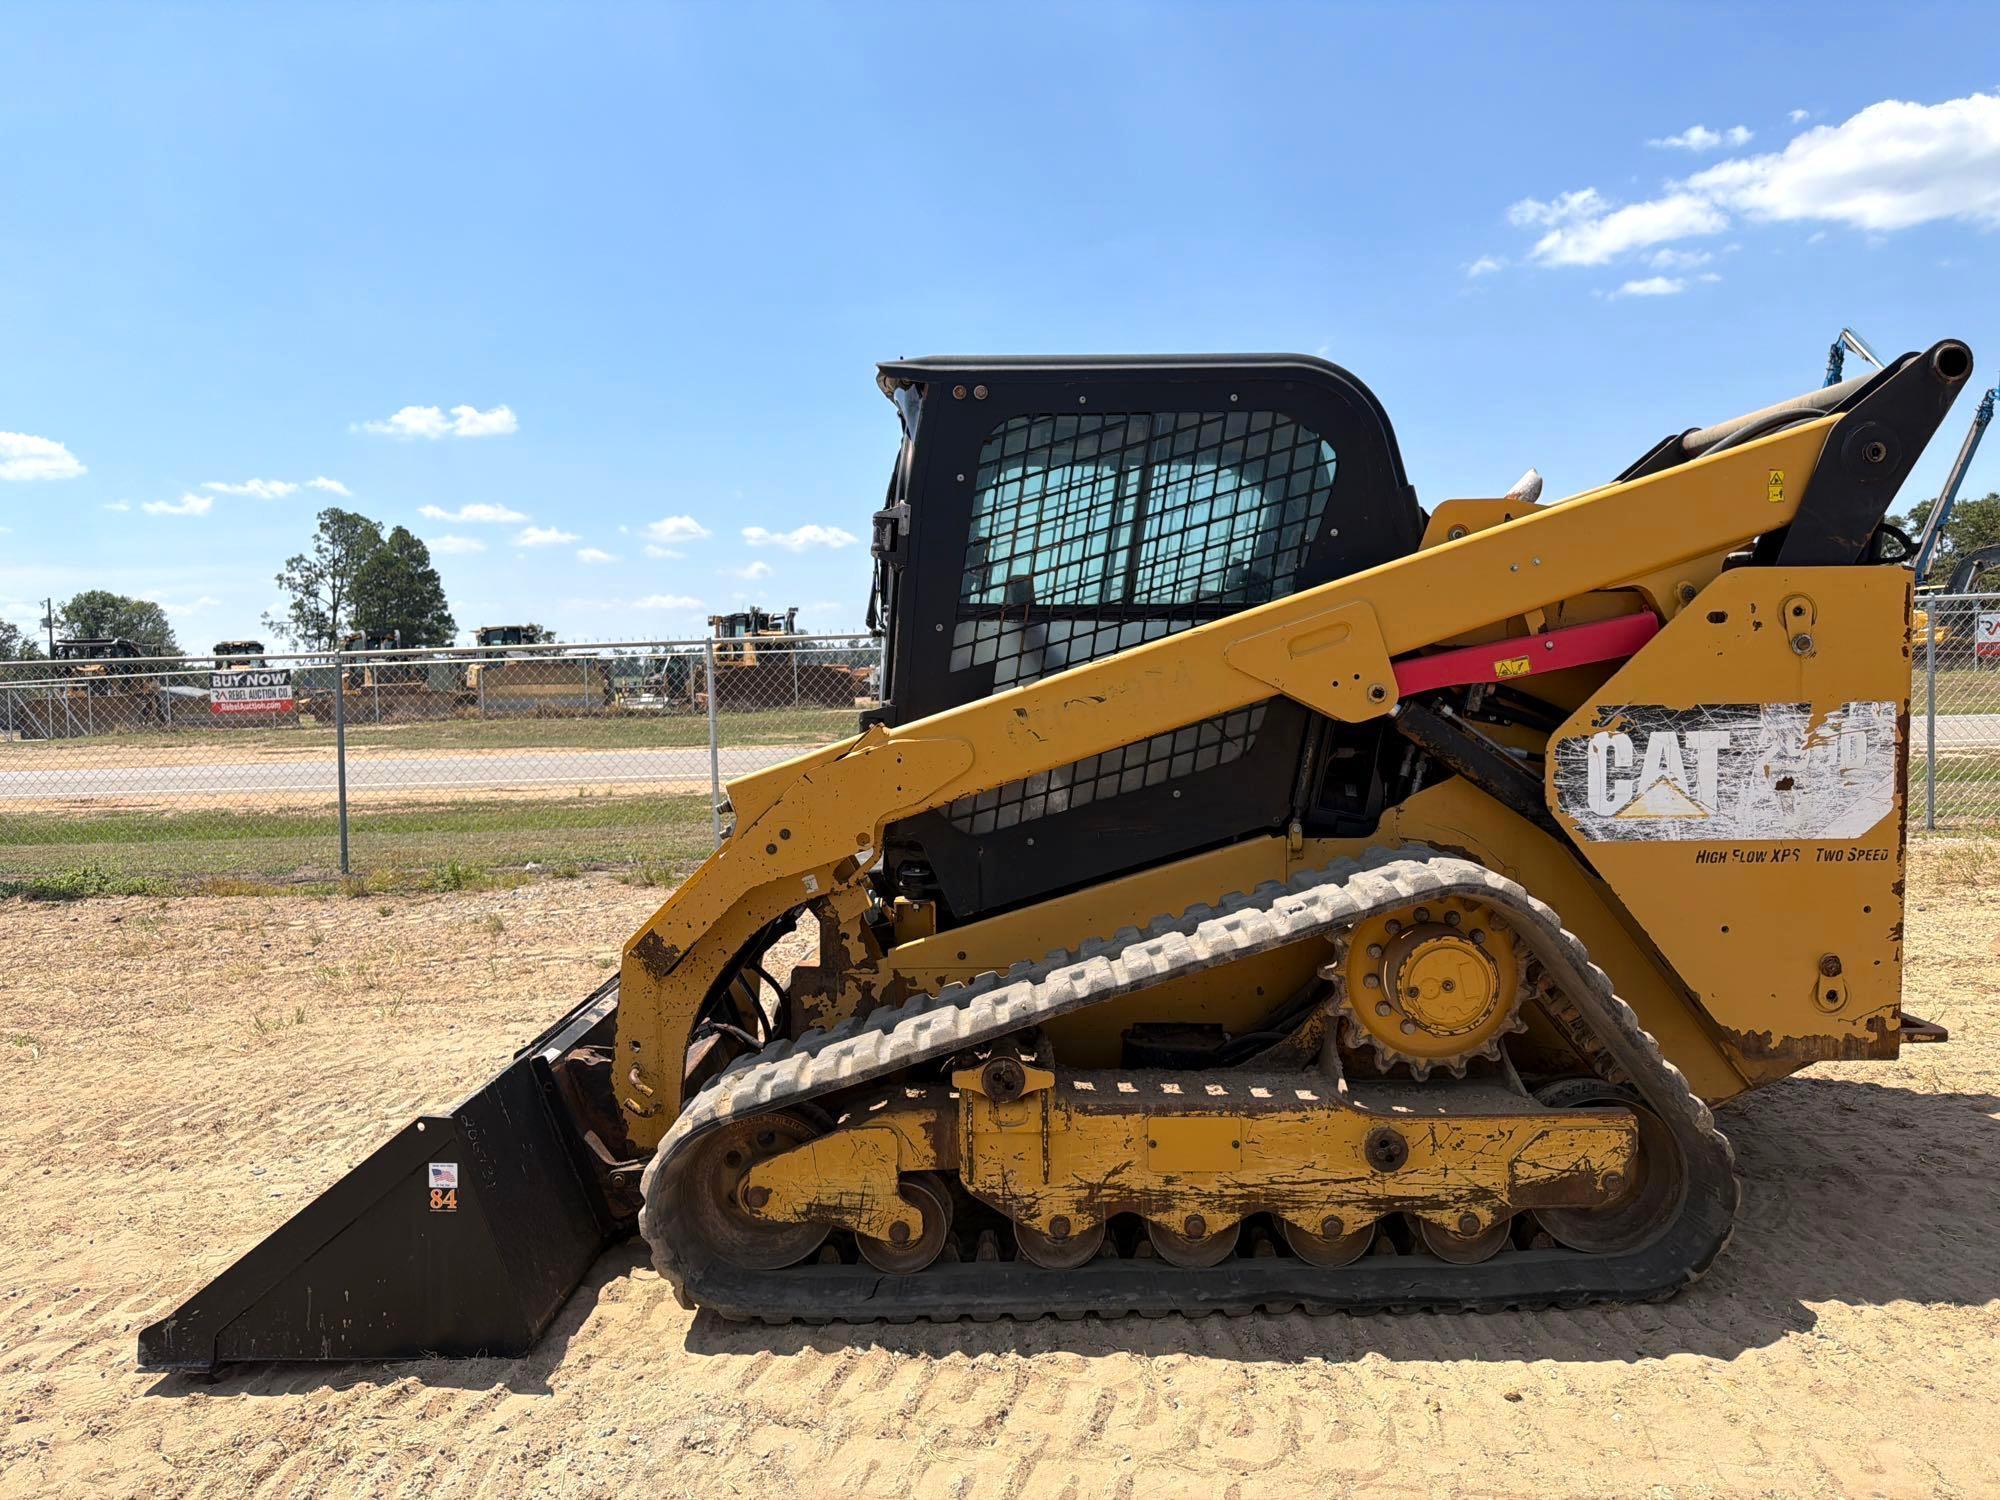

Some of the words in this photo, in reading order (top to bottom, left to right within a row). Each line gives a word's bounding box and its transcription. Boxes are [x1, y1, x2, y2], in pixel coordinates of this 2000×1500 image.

[212, 674, 245, 687] BUY
[246, 672, 287, 686] NOW
[228, 690, 247, 700] REBEL
[248, 689, 276, 700] AUCTION
[278, 687, 291, 699] CO.
[1588, 731, 1730, 817] CAT
[1695, 849, 1727, 864] HIGH
[1770, 848, 1801, 863] XPS
[1815, 848, 1845, 862] TWO
[429, 1188, 458, 1209] 84
